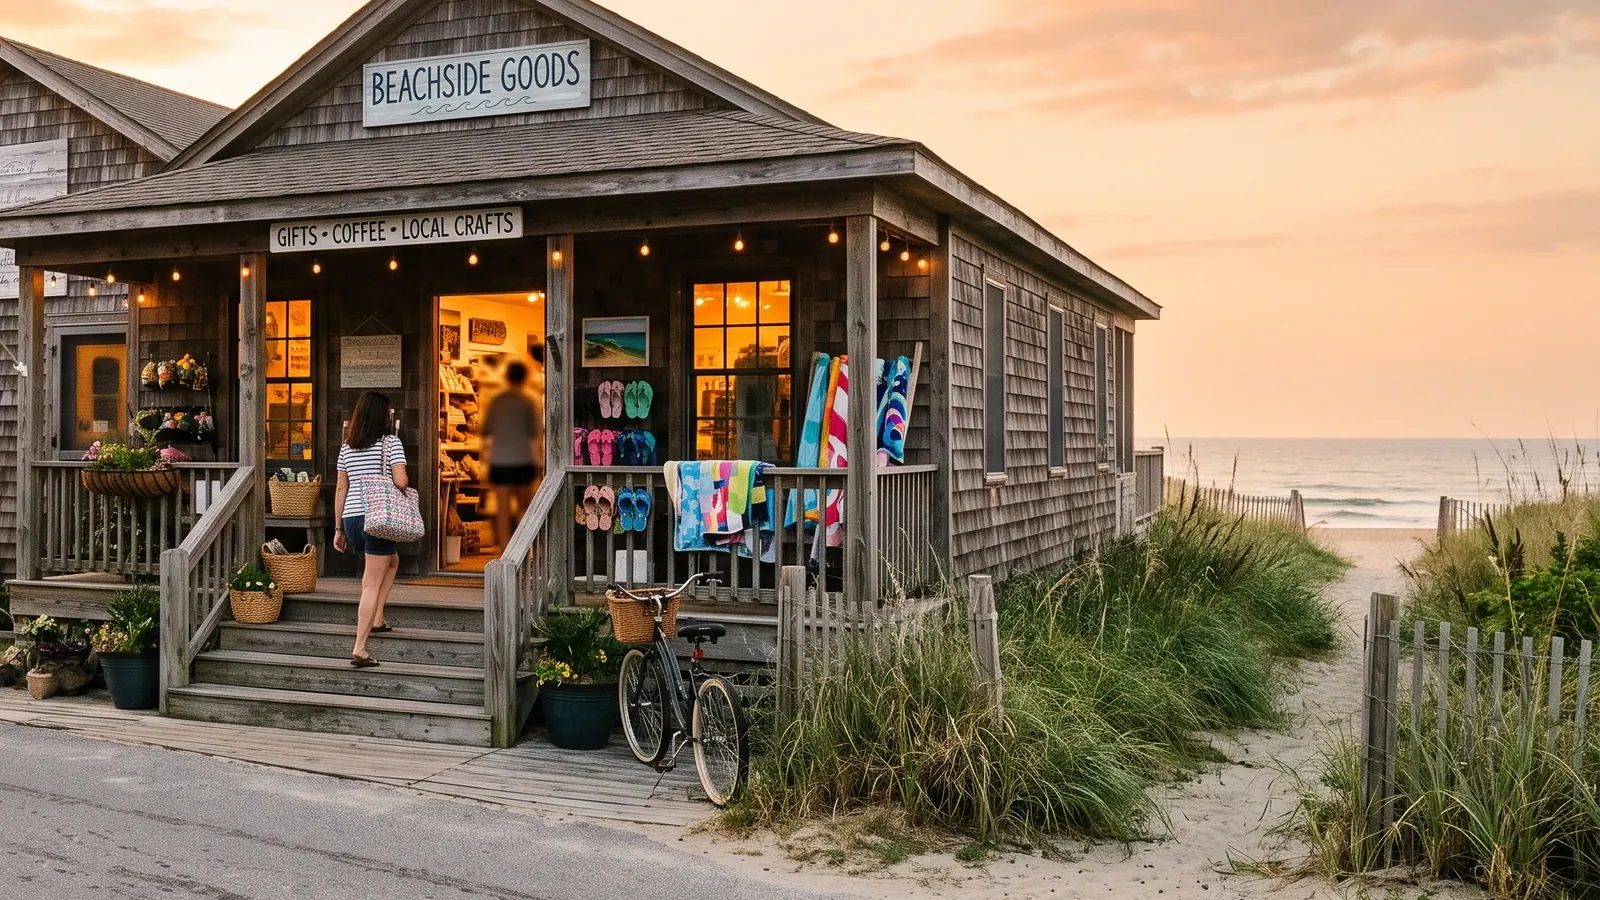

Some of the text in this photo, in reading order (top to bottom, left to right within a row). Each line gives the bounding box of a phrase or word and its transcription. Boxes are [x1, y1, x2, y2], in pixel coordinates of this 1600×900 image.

[372, 50, 580, 106] BEACHSIDE GOODS
[277, 212, 514, 247] GIFTS COFFEE LOCAL CRAFTS
